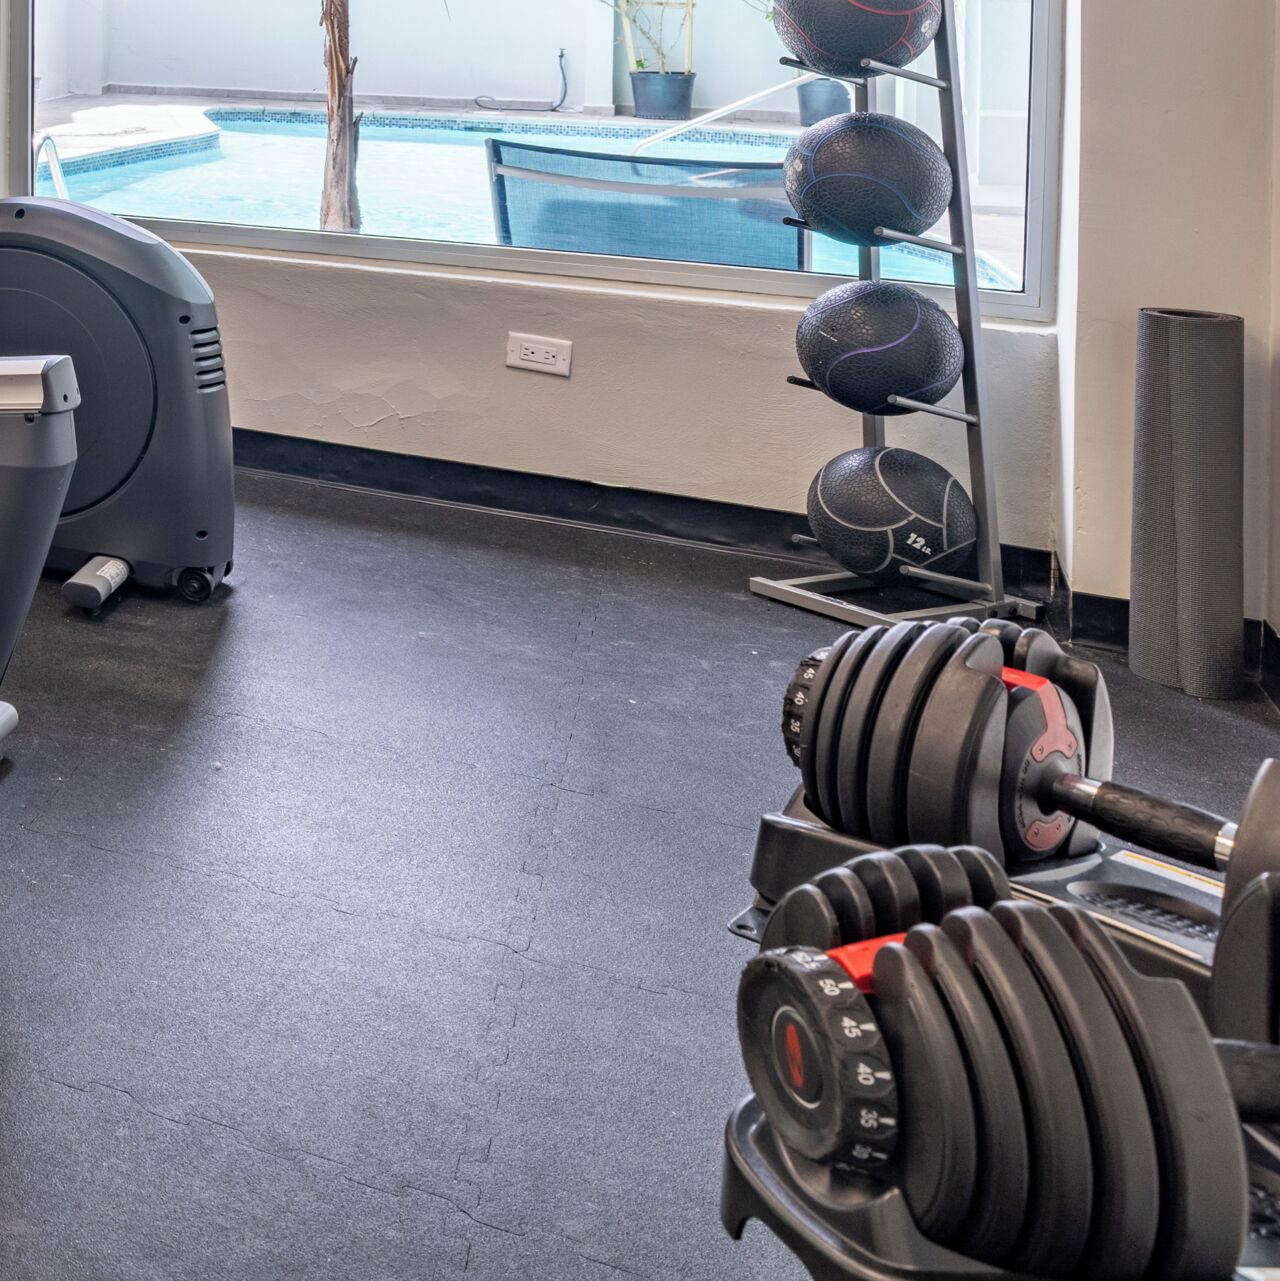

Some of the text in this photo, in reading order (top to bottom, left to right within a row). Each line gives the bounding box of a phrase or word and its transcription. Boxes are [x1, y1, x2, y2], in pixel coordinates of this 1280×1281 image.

[906, 532, 926, 550] 12
[803, 667, 815, 679] 45
[794, 691, 804, 705] 40
[790, 720, 800, 733] 35
[819, 979, 840, 996] 50
[841, 1016, 861, 1038] 45
[856, 1062, 875, 1085] 40
[860, 1109, 877, 1129] 35
